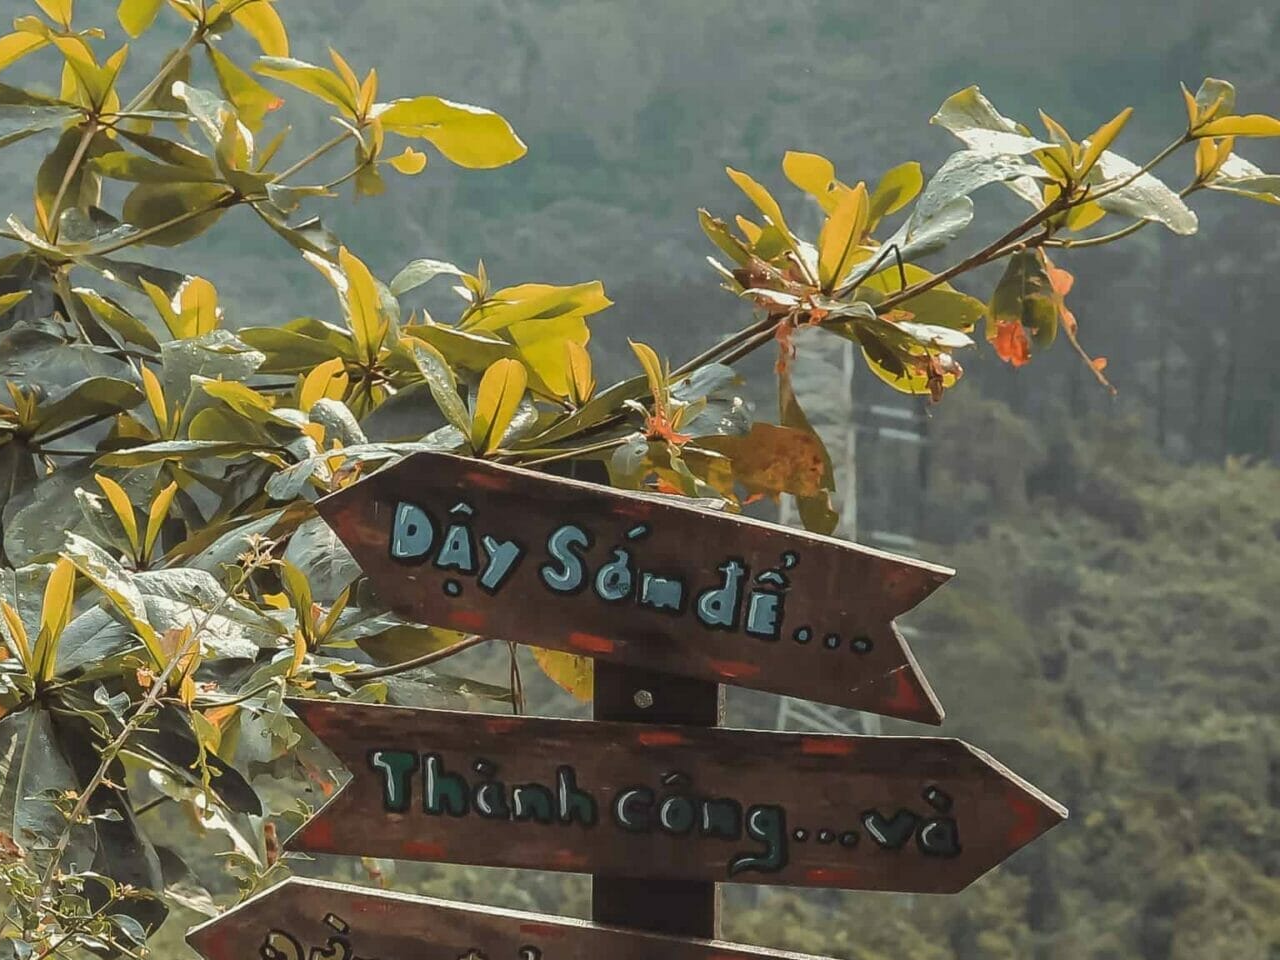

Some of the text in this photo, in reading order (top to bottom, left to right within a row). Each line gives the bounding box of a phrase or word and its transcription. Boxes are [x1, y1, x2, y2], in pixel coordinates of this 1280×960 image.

[539, 521, 685, 614] Sớm
[369, 748, 598, 827] Thành
[861, 785, 962, 856] và
